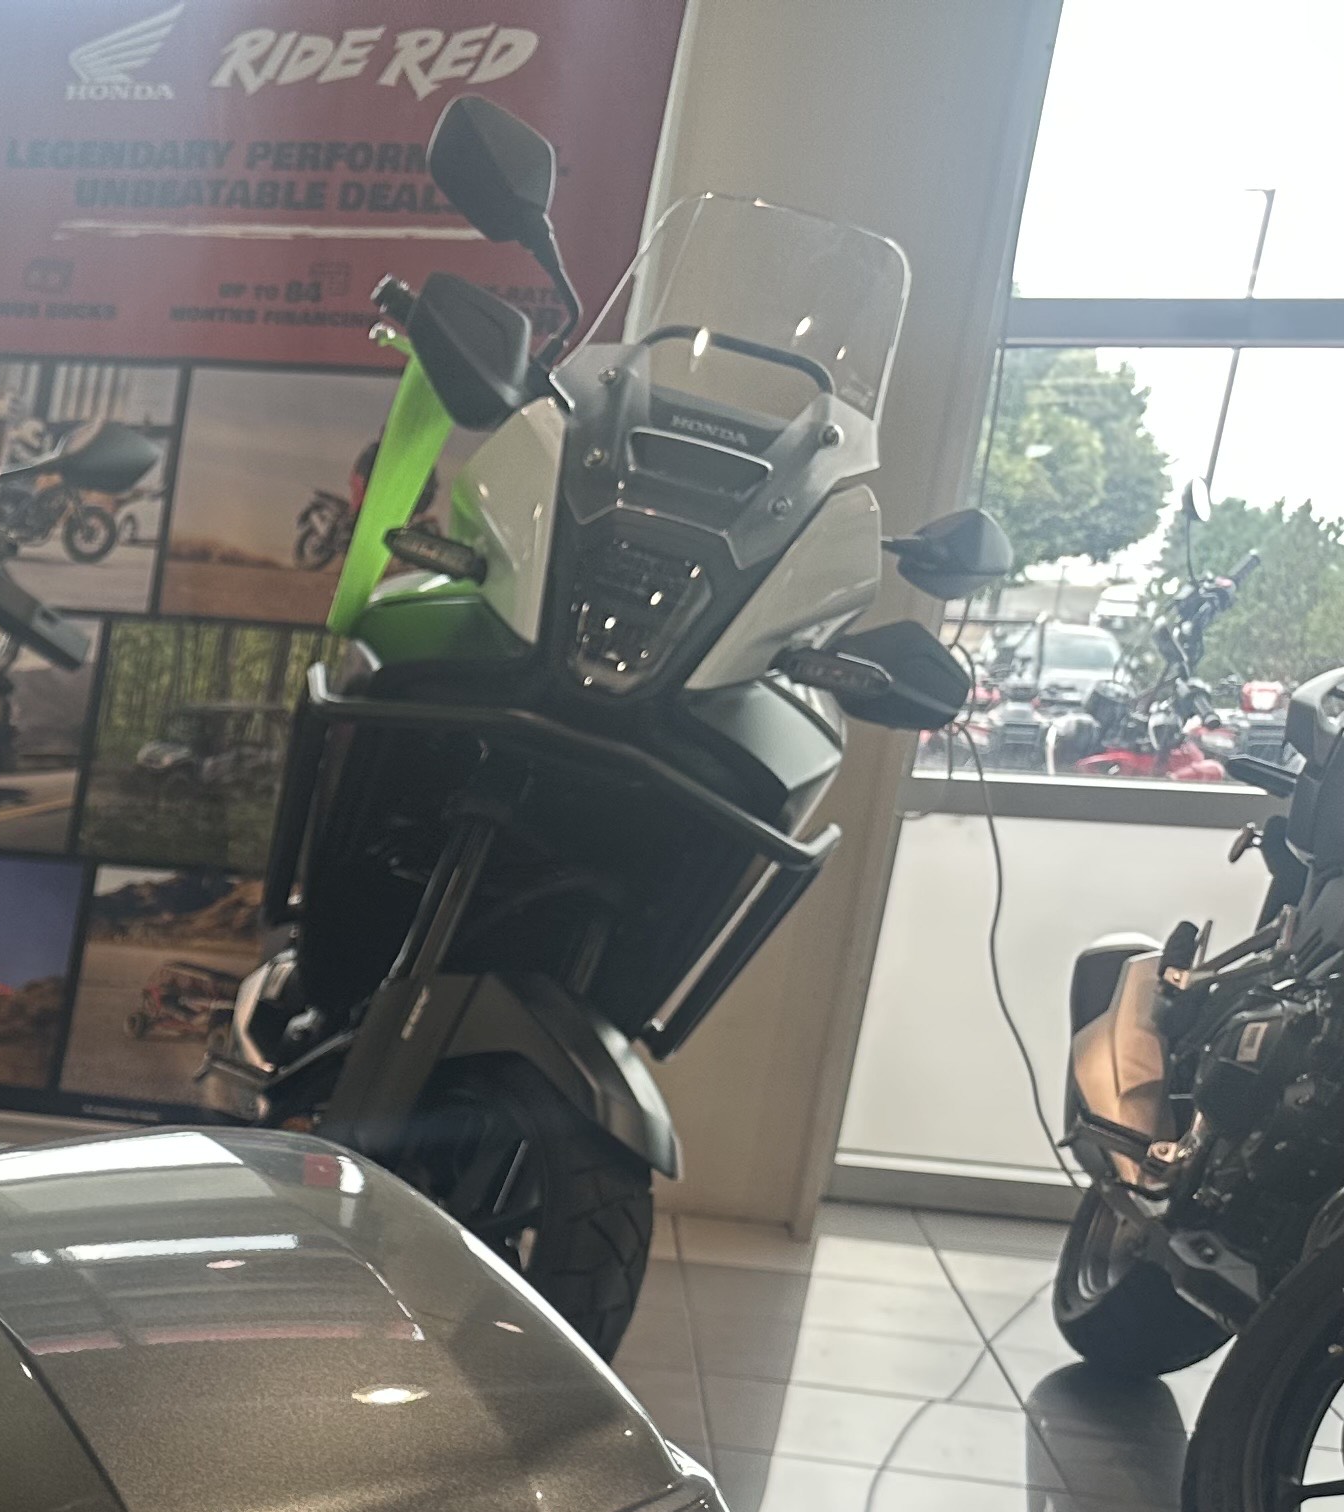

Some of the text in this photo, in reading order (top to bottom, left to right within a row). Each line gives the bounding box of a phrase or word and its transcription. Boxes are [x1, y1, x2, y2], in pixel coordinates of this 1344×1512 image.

[210, 22, 540, 102] RIDE RED
[66, 84, 175, 101] HONDA
[5, 138, 234, 170] LEGENDARY
[74, 177, 328, 211] UNBEATABLE
[672, 415, 748, 448] HONDA
